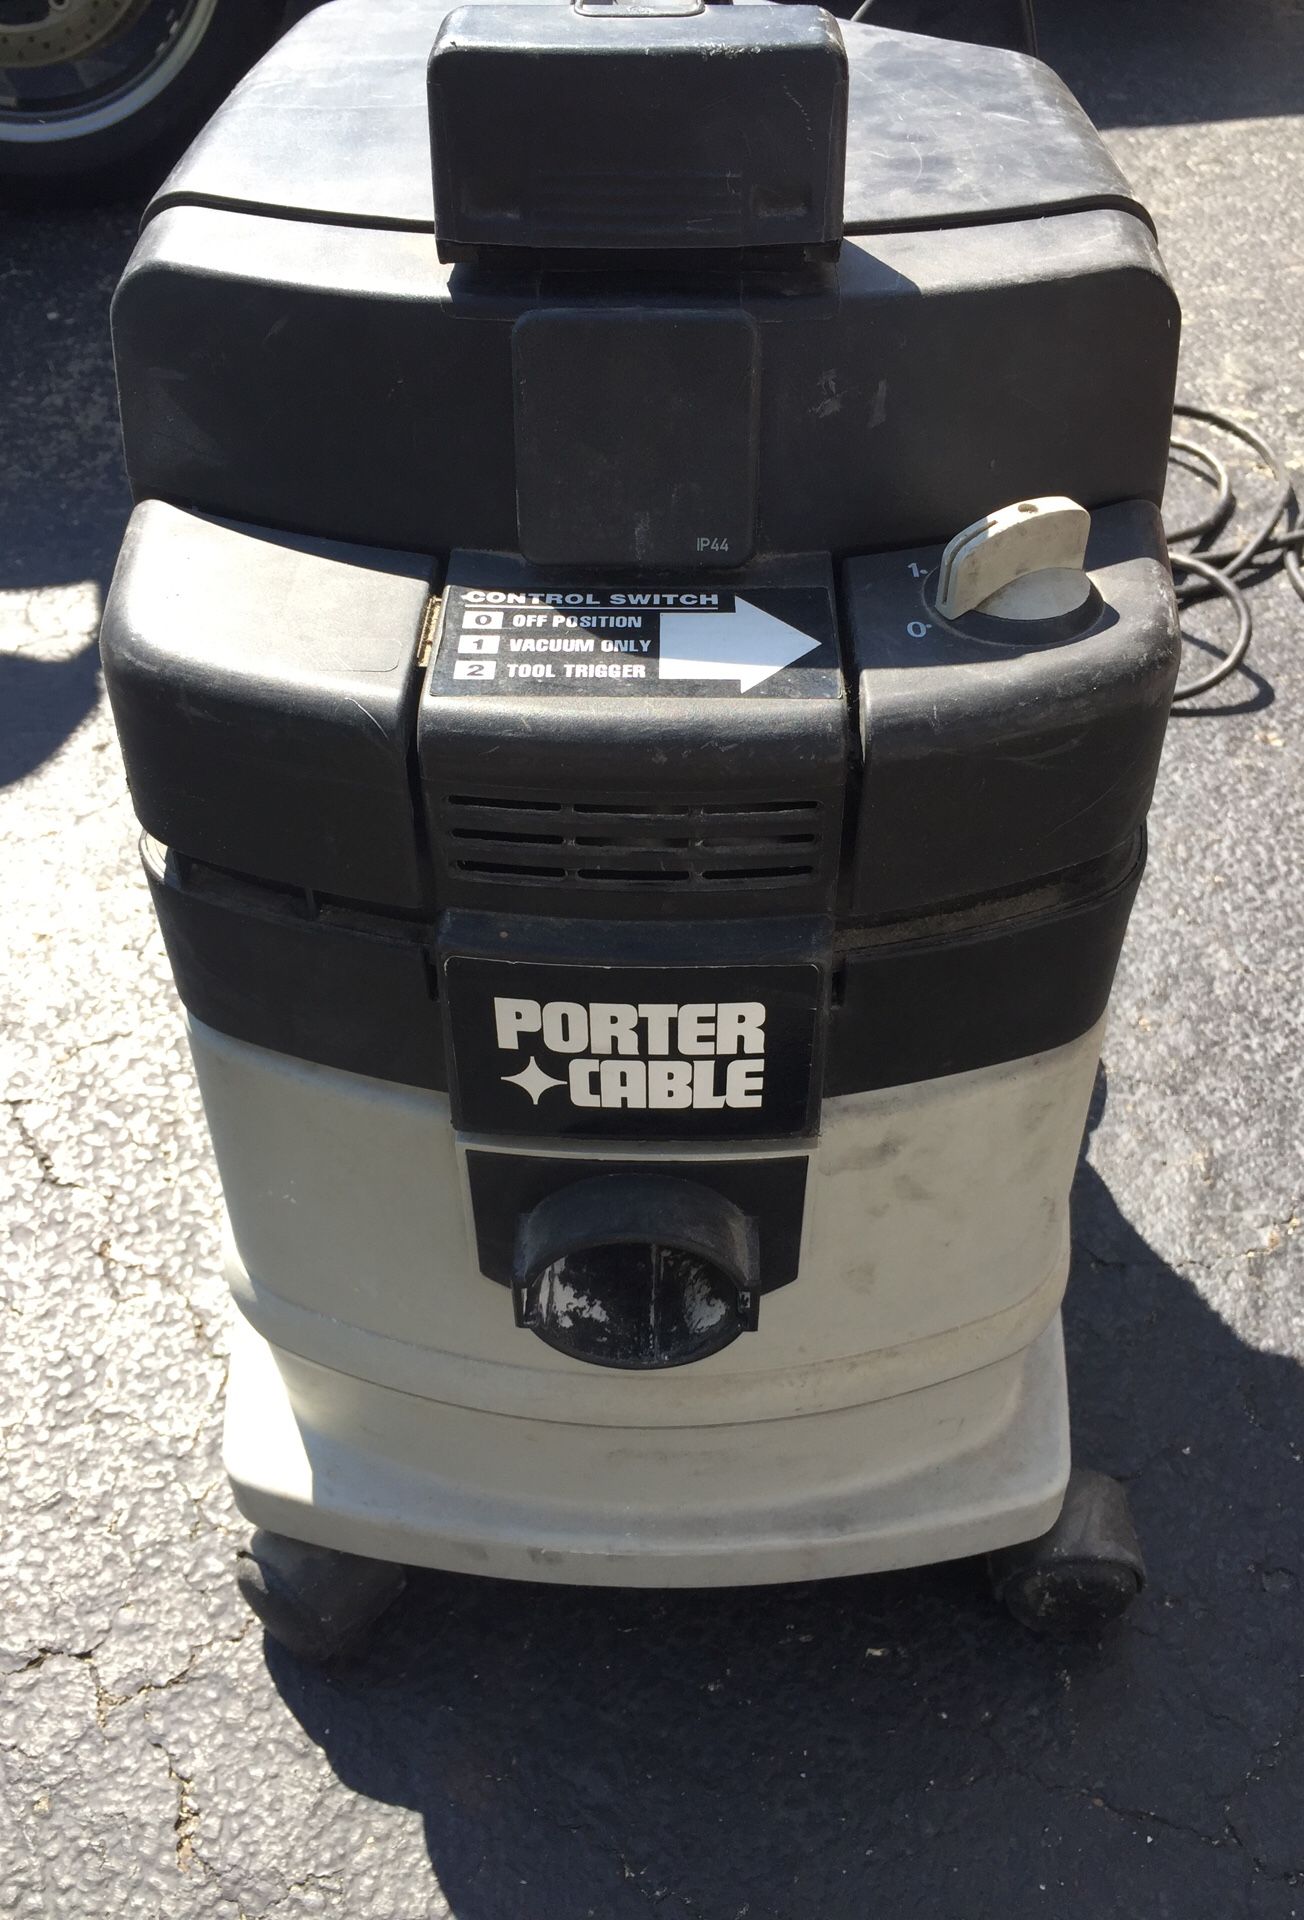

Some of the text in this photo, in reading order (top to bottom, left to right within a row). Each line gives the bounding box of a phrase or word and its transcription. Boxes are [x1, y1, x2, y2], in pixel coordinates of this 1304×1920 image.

[696, 537, 729, 552] IP44
[465, 591, 719, 606] CONTROL SWITCH
[512, 615, 548, 628] OFF
[556, 615, 642, 628] POSITION
[473, 639, 652, 653] 1 VACUUM ONLY
[466, 664, 646, 678] 2 TOOL TRIGGER
[494, 997, 766, 1055] PORTER
[568, 1058, 765, 1109] CABLE
